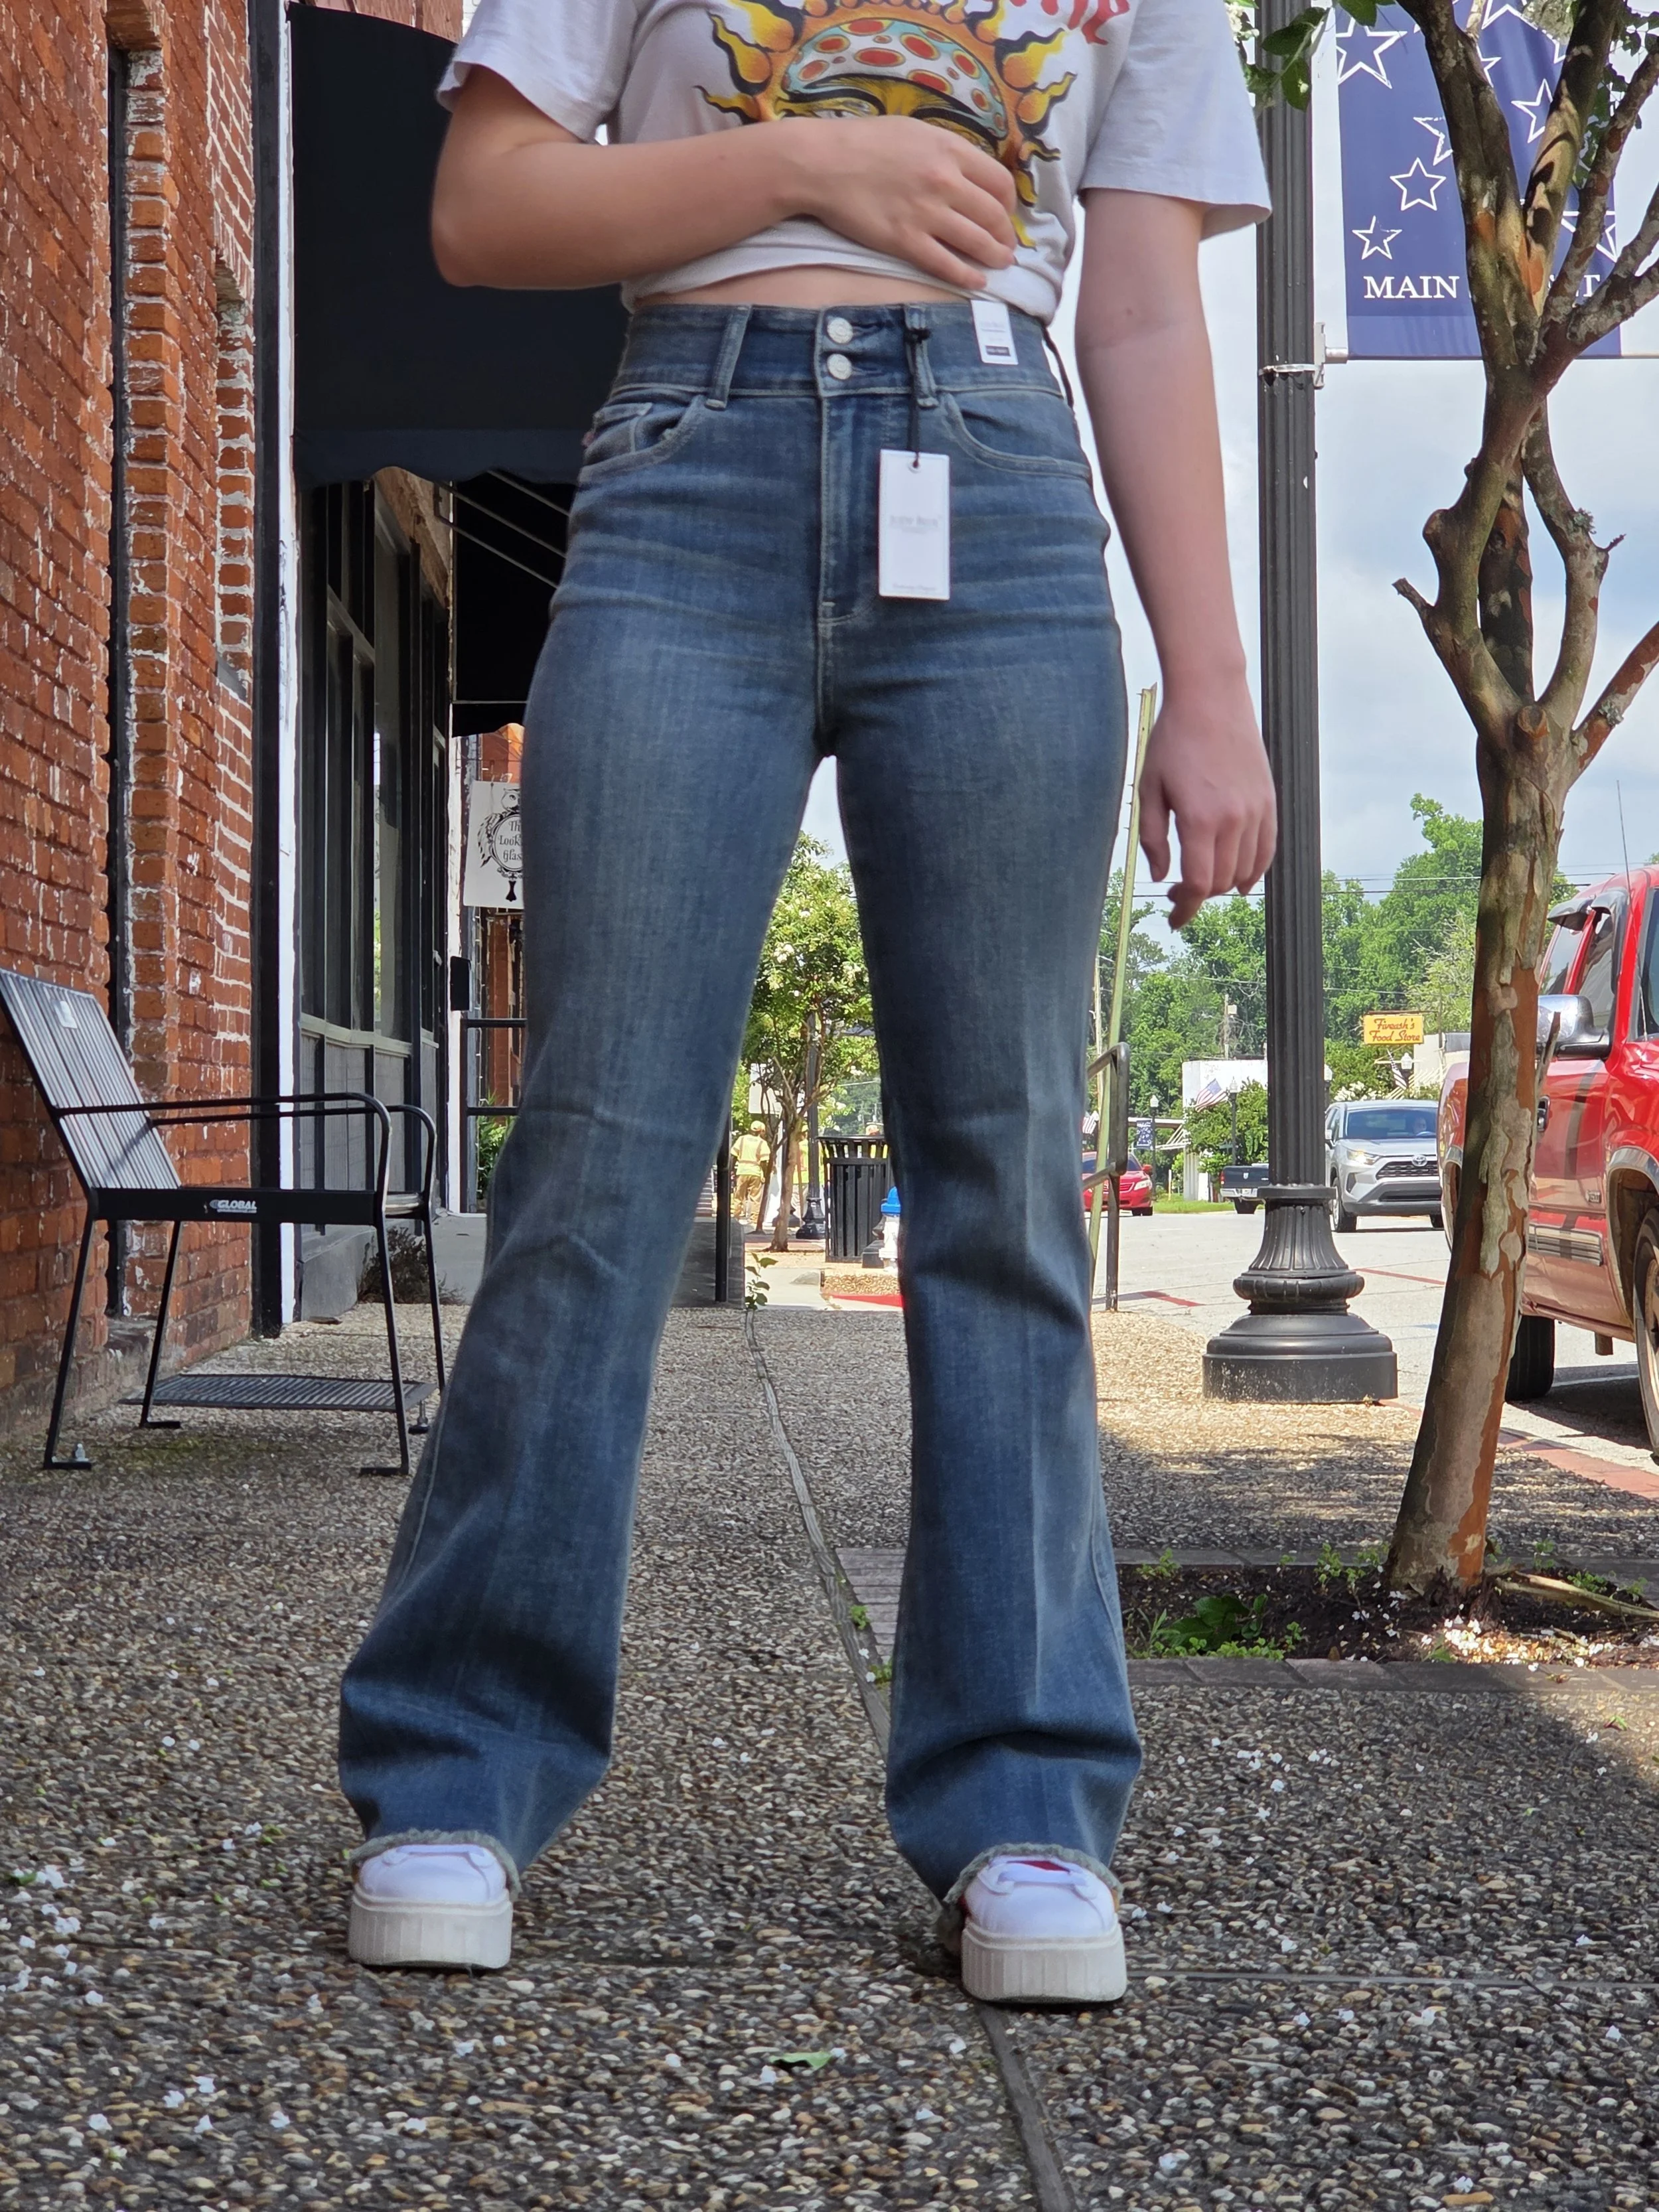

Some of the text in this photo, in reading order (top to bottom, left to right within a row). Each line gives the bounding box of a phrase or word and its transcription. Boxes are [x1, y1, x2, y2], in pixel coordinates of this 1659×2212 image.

[1363, 275, 1460, 299] MAIN
[508, 820, 522, 832] Th
[498, 834, 522, 846] Look
[503, 848, 523, 863] Glas
[1369, 1029, 1420, 1042] Food Store
[217, 1199, 257, 1209] GLOBAL
